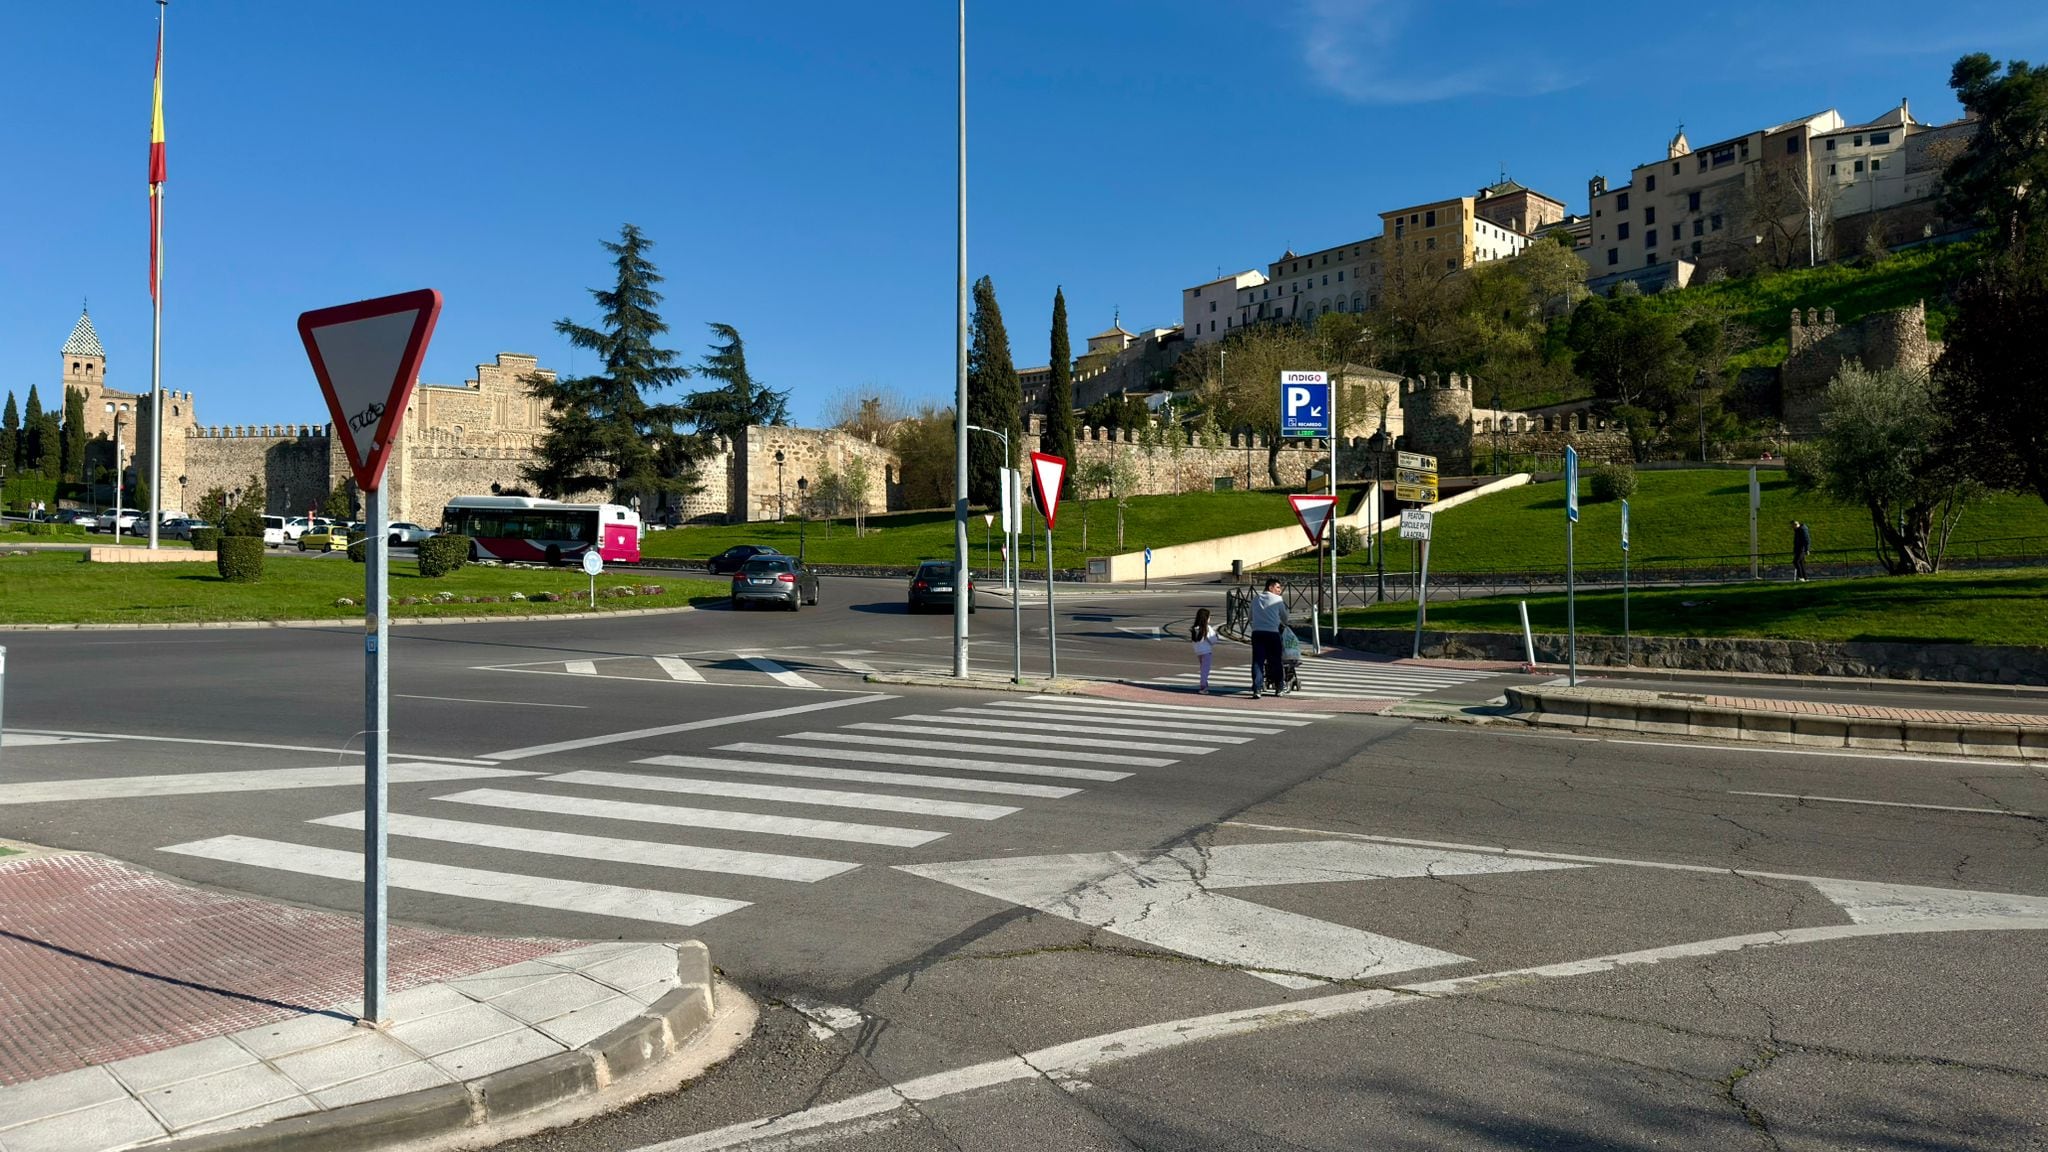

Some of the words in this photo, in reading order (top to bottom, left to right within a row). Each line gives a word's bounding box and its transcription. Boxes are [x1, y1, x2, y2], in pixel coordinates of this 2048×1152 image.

[1288, 374, 1322, 382] INDIGO
[1288, 387, 1311, 417] P
[1401, 521, 1419, 529] CIRCULE
[1410, 531, 1424, 539] ACERA
